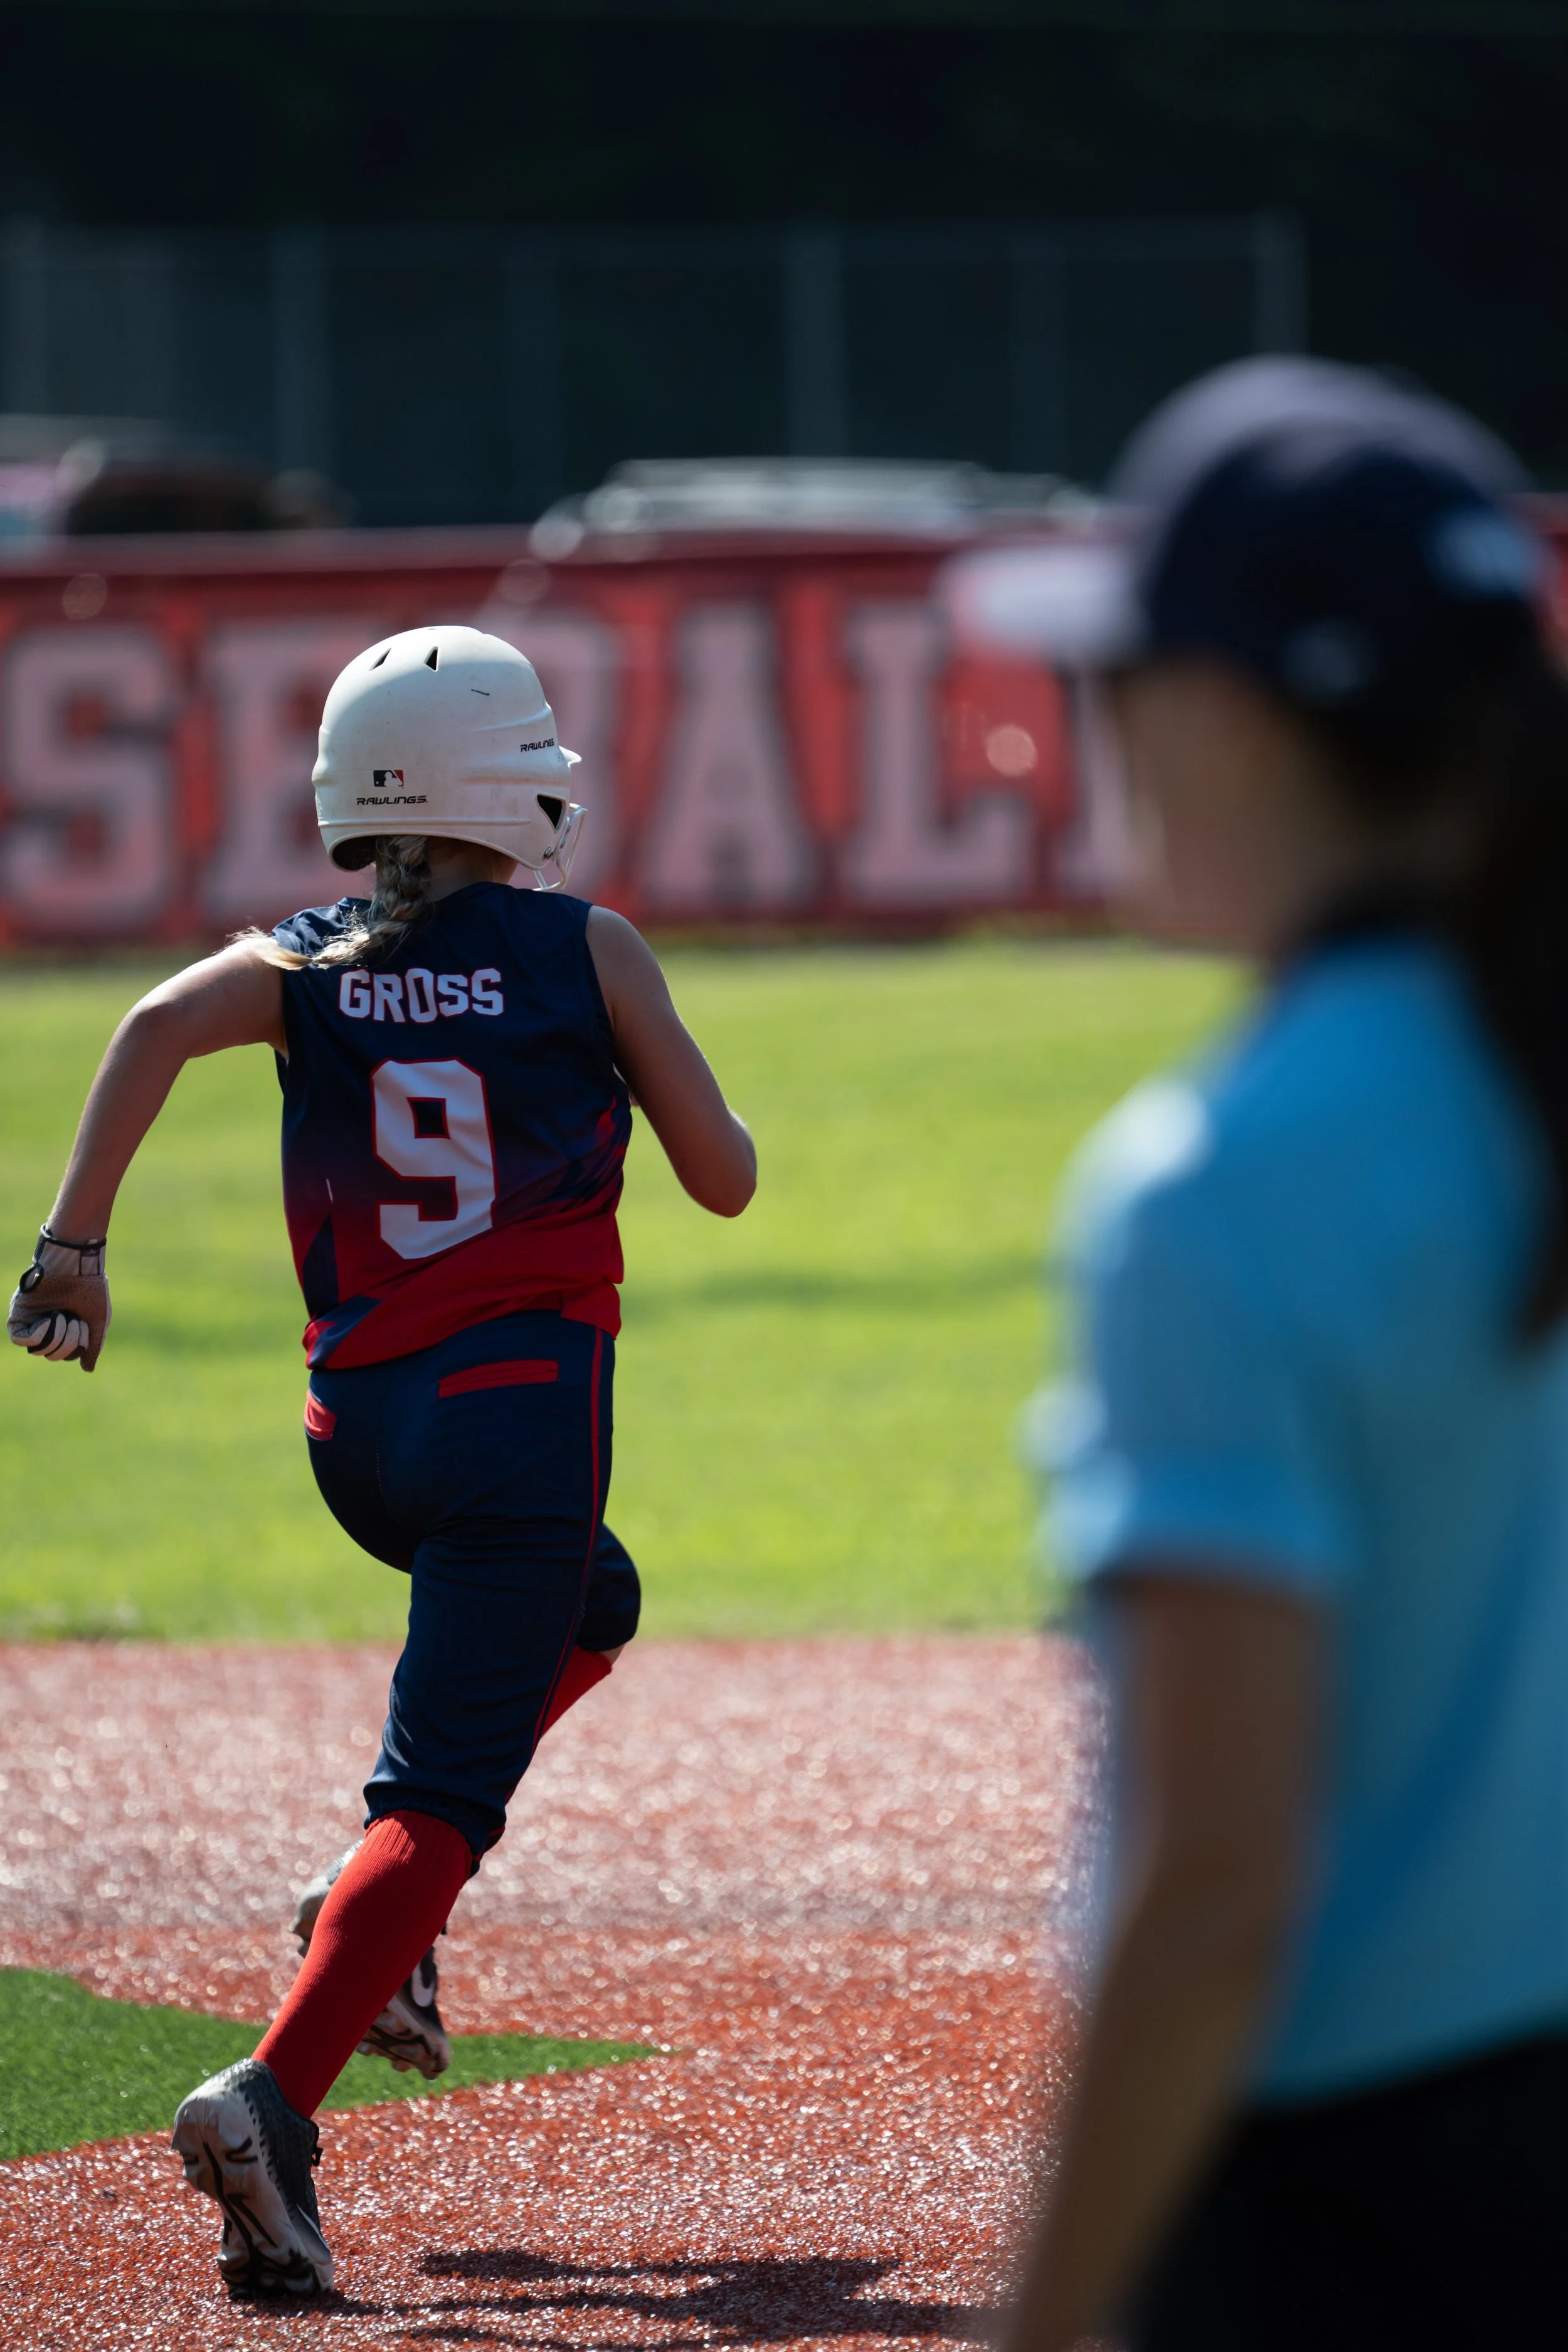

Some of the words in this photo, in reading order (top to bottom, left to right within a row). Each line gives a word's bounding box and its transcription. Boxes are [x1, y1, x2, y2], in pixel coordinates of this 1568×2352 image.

[520, 738, 554, 753] RAWLINGS
[356, 795, 428, 805] RAWLINGS
[339, 968, 504, 1022] GROSS
[371, 1057, 498, 1259] 9
